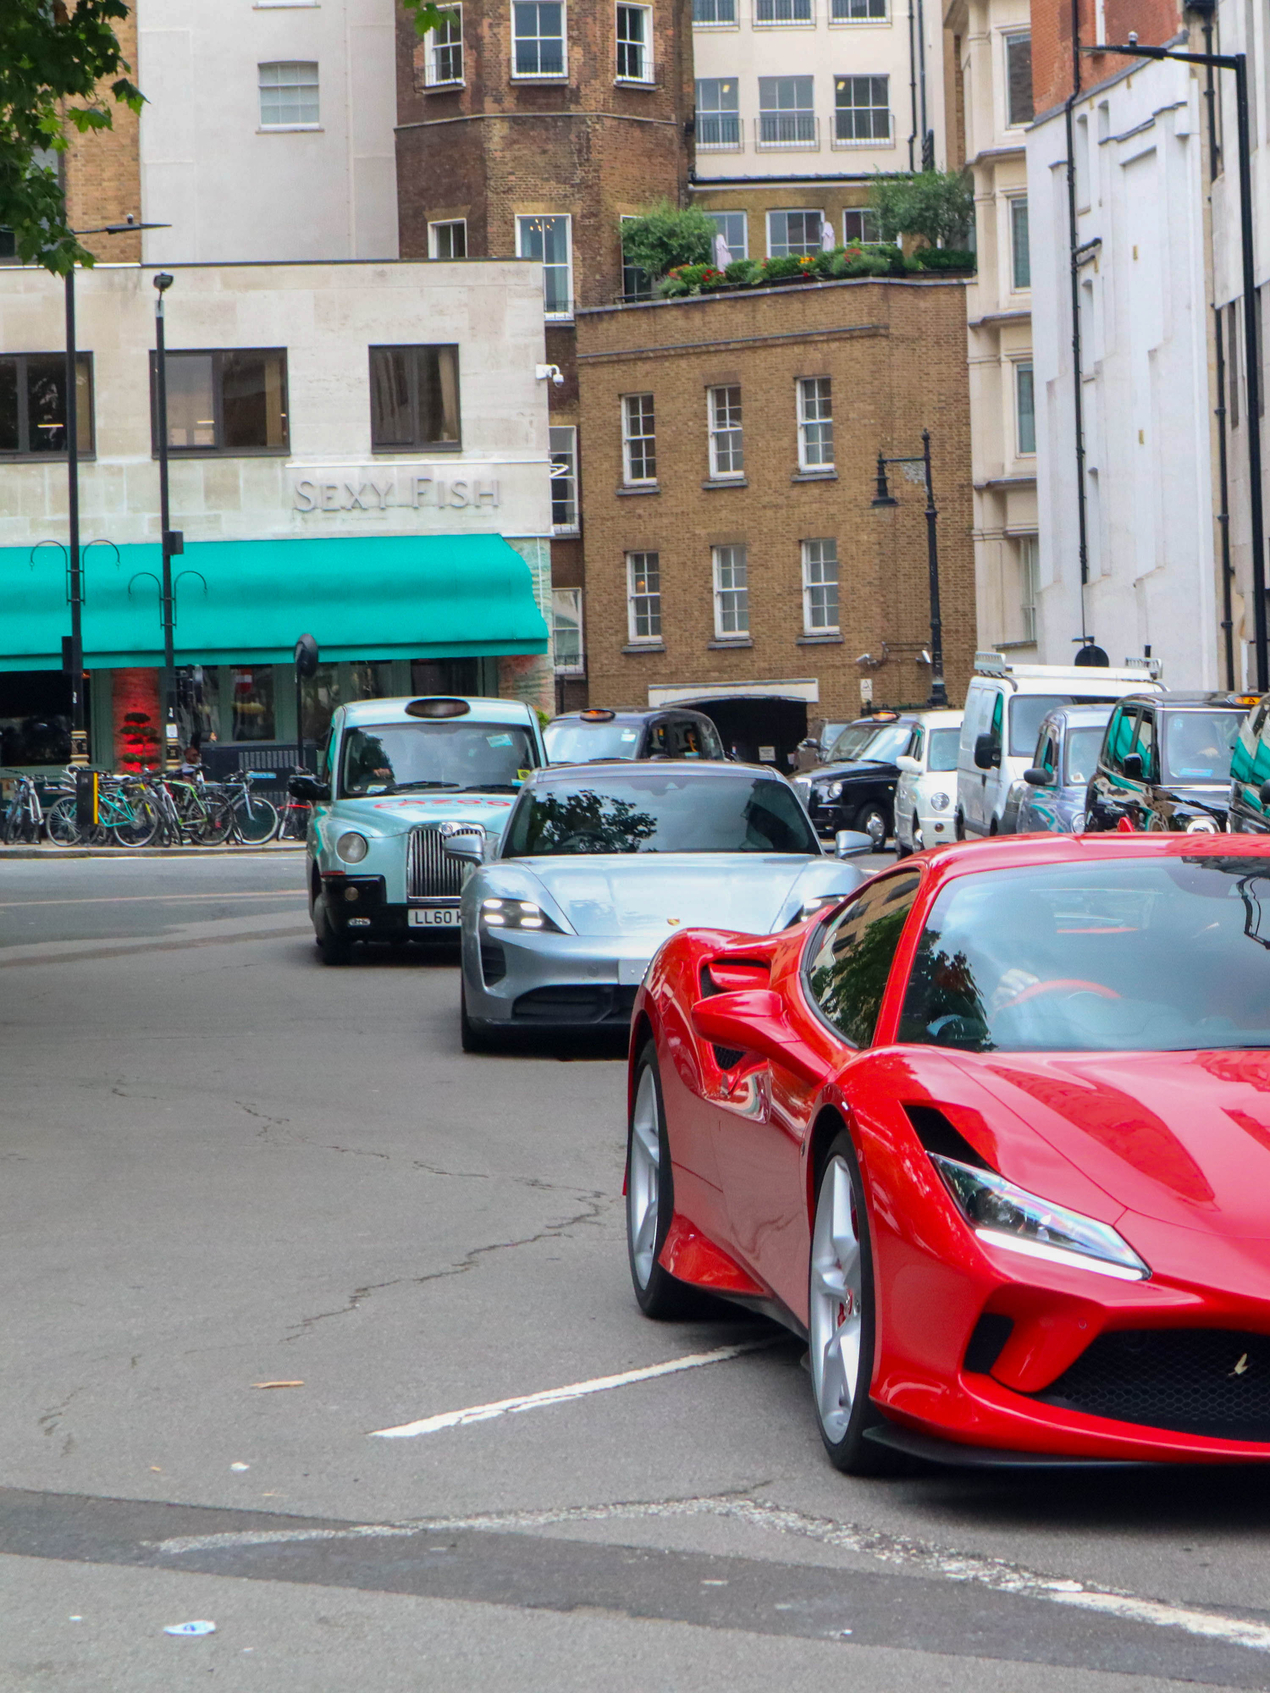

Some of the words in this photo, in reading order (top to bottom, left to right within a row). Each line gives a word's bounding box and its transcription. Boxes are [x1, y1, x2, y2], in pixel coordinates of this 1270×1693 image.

[295, 480, 393, 512] SEXY
[411, 476, 500, 509] FISH
[415, 911, 452, 924] LL60
